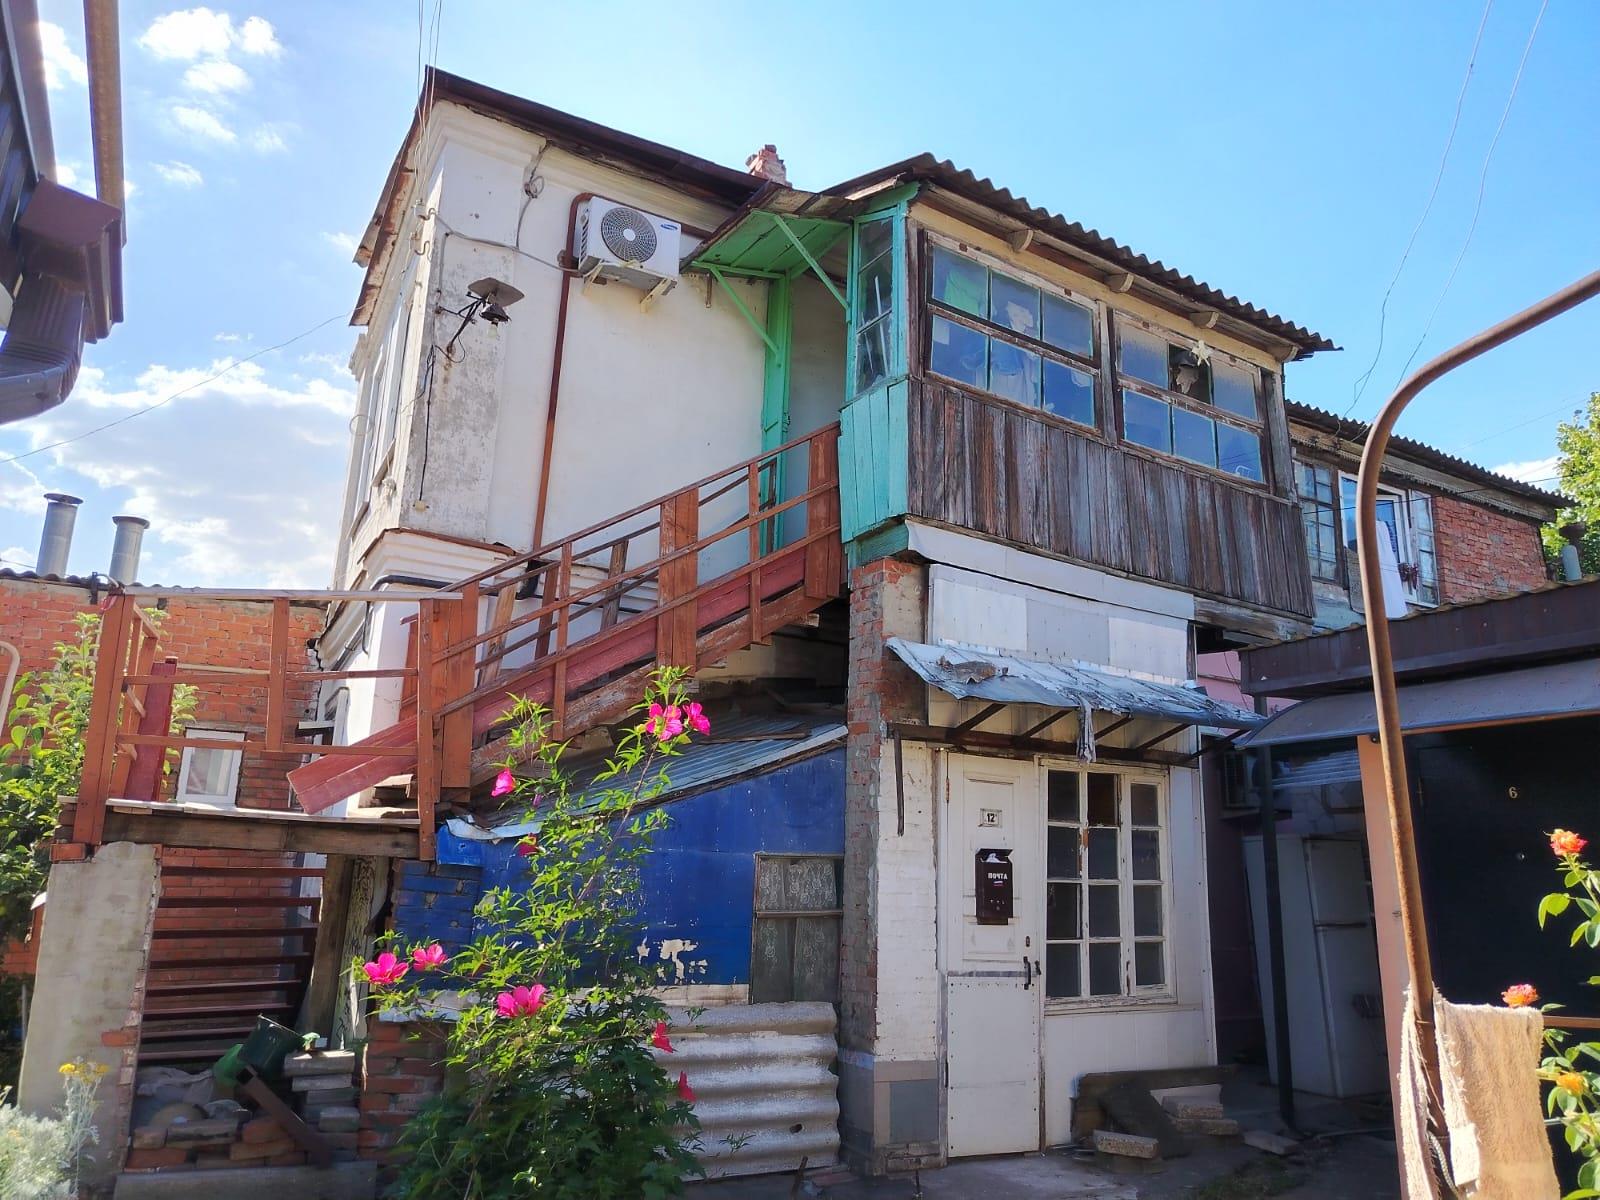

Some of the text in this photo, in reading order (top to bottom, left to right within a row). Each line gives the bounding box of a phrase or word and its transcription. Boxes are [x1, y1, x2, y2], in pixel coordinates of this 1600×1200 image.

[1508, 786, 1518, 799] 6
[986, 812, 996, 823] 12
[987, 872, 1008, 880] ПОЧТА
